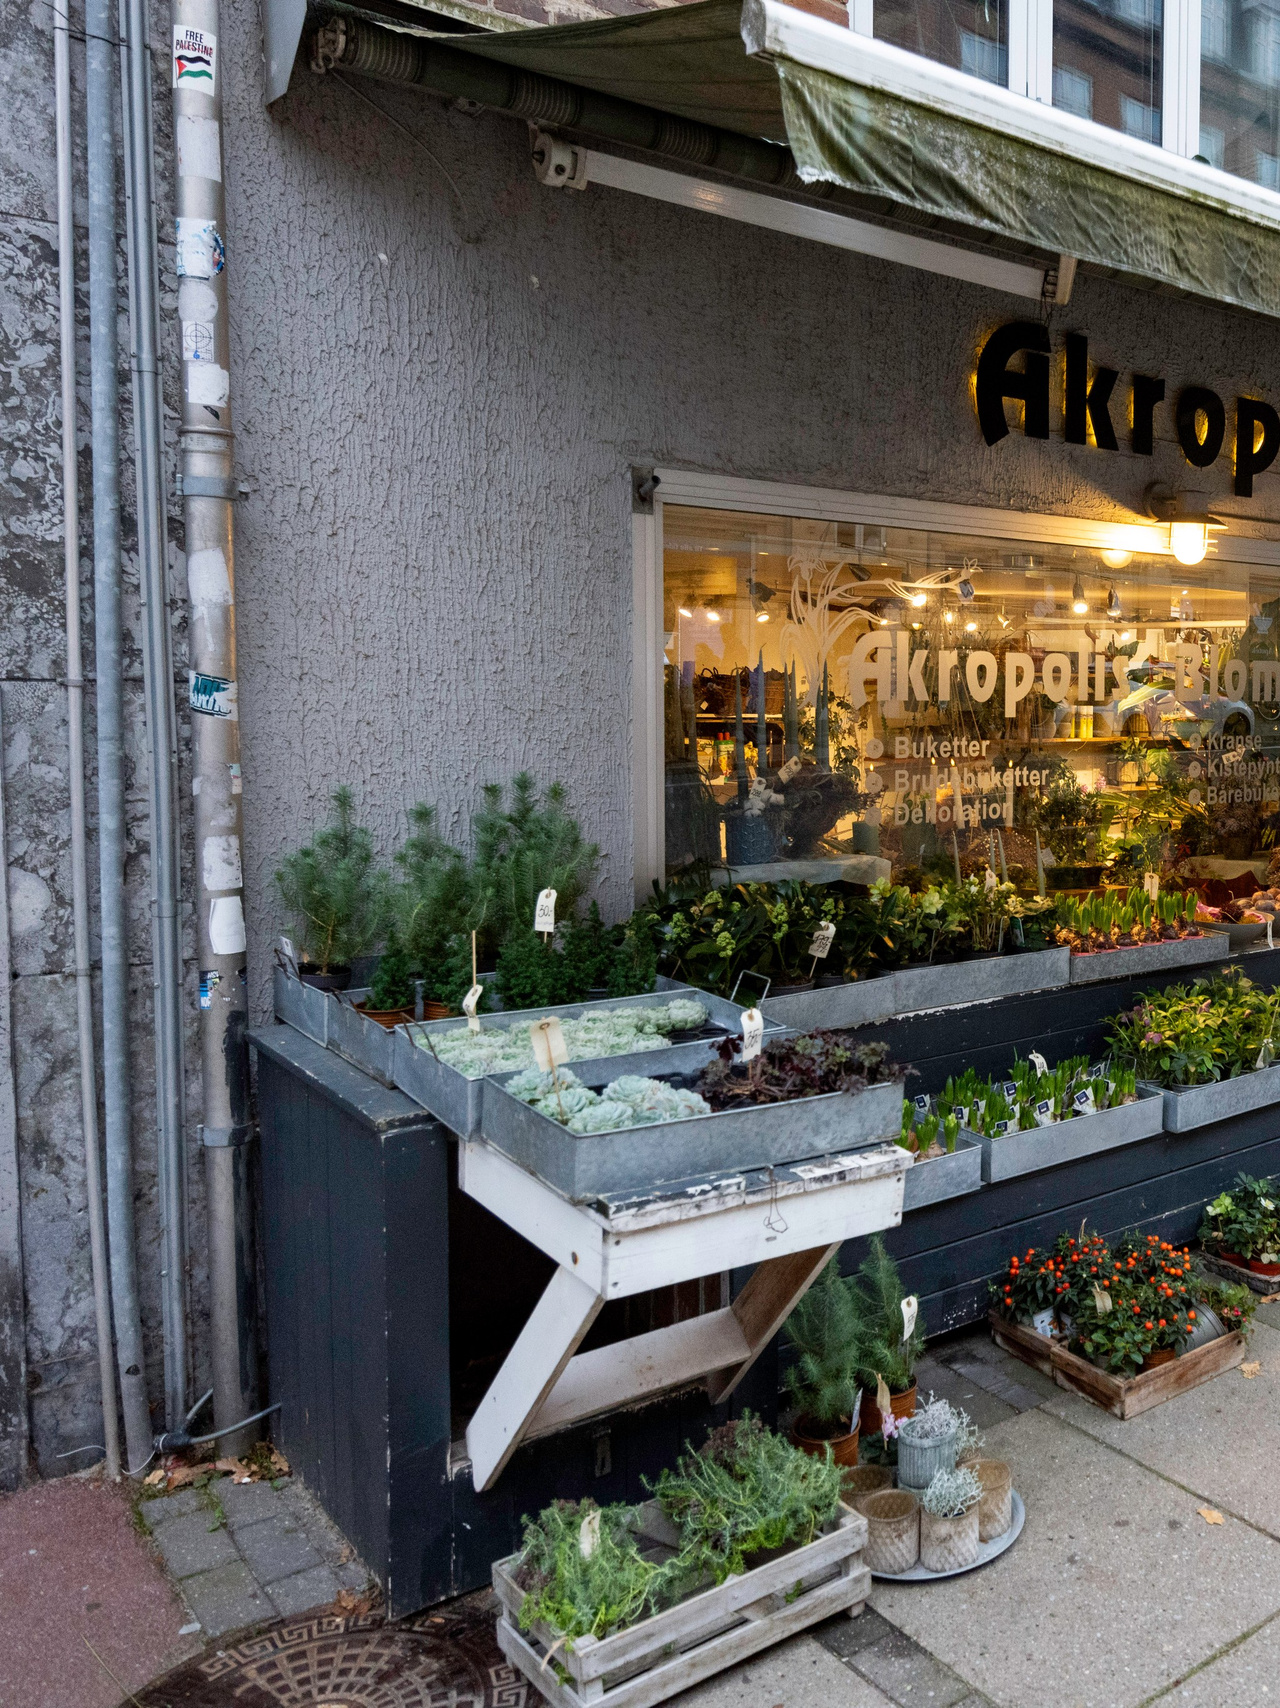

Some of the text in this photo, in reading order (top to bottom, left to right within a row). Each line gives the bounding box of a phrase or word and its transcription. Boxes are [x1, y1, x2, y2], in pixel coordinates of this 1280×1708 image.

[185, 30, 204, 44] FREE
[175, 39, 213, 58] PALESTINE
[847, 630, 1131, 718] Akropolis
[894, 735, 991, 759] Buketter
[1207, 731, 1262, 751] Kranse
[1207, 756, 1280, 780] Kistepynt
